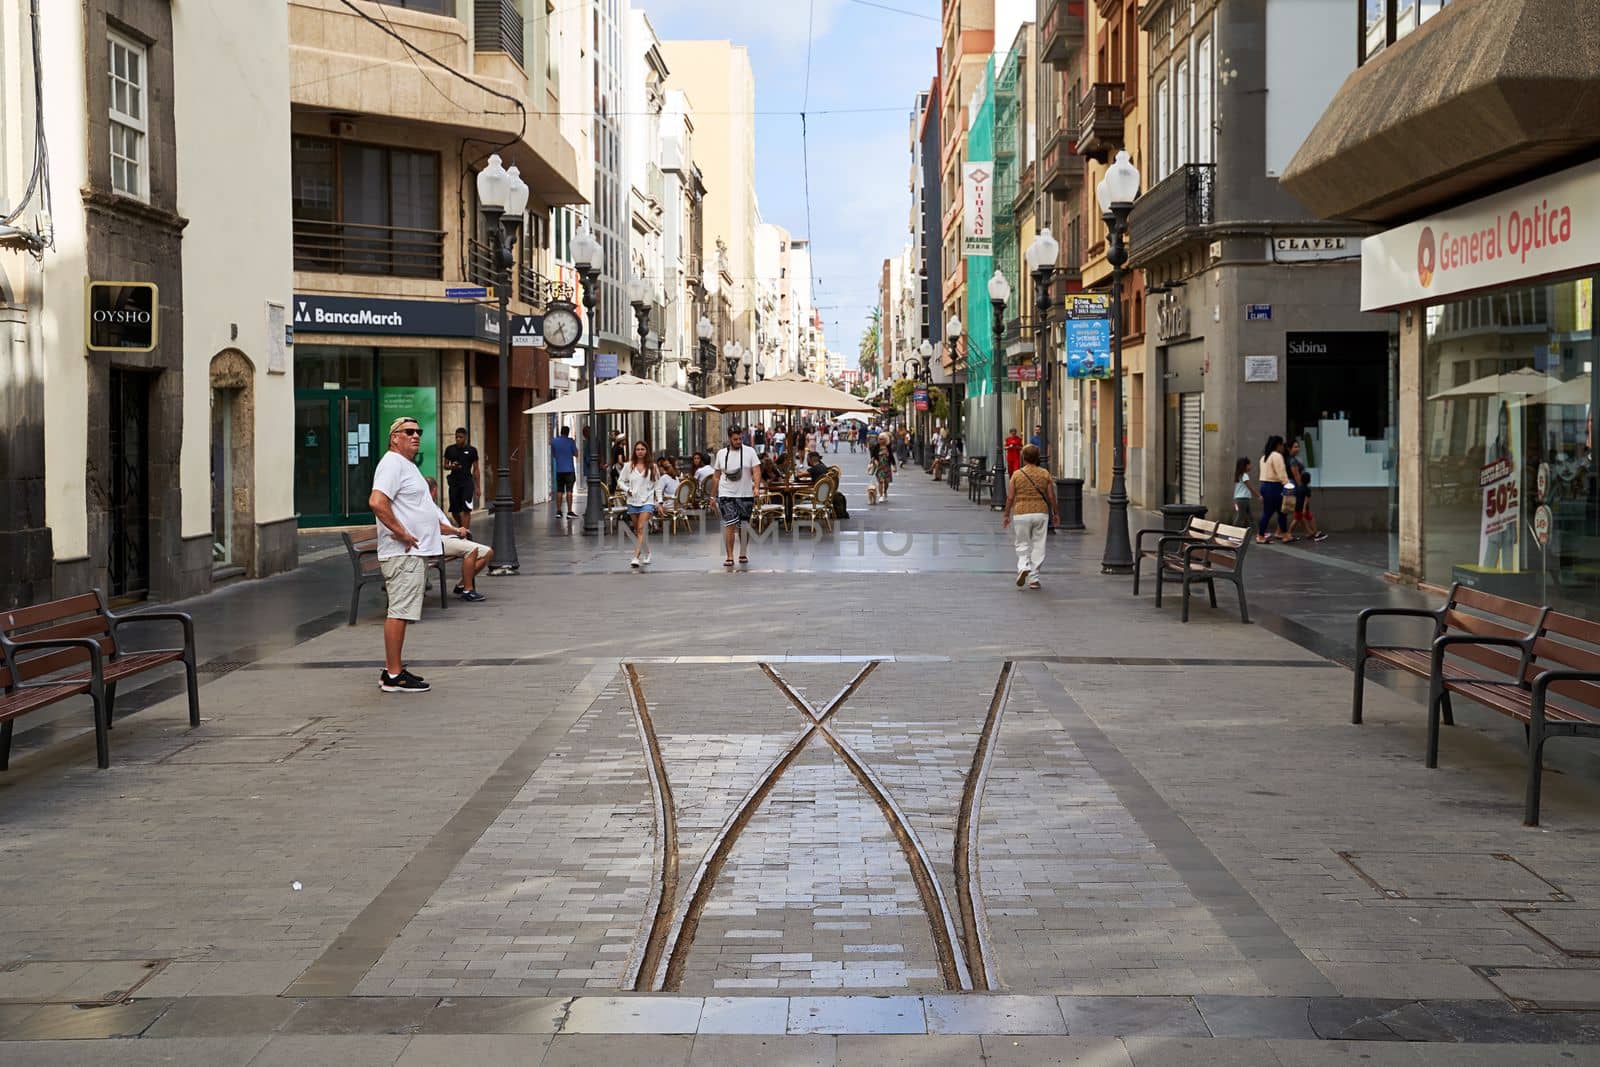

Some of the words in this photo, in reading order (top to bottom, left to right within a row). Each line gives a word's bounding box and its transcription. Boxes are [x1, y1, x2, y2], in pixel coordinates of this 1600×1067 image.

[974, 185, 985, 236] BIBIANO
[1277, 238, 1345, 250] CLAVEL
[1439, 215, 1503, 271] General
[1507, 199, 1572, 264] Optica
[93, 309, 151, 324] OYSHO
[314, 307, 403, 327] BancaMarch
[1288, 340, 1327, 354] Sabina
[1486, 480, 1519, 518] 50%
